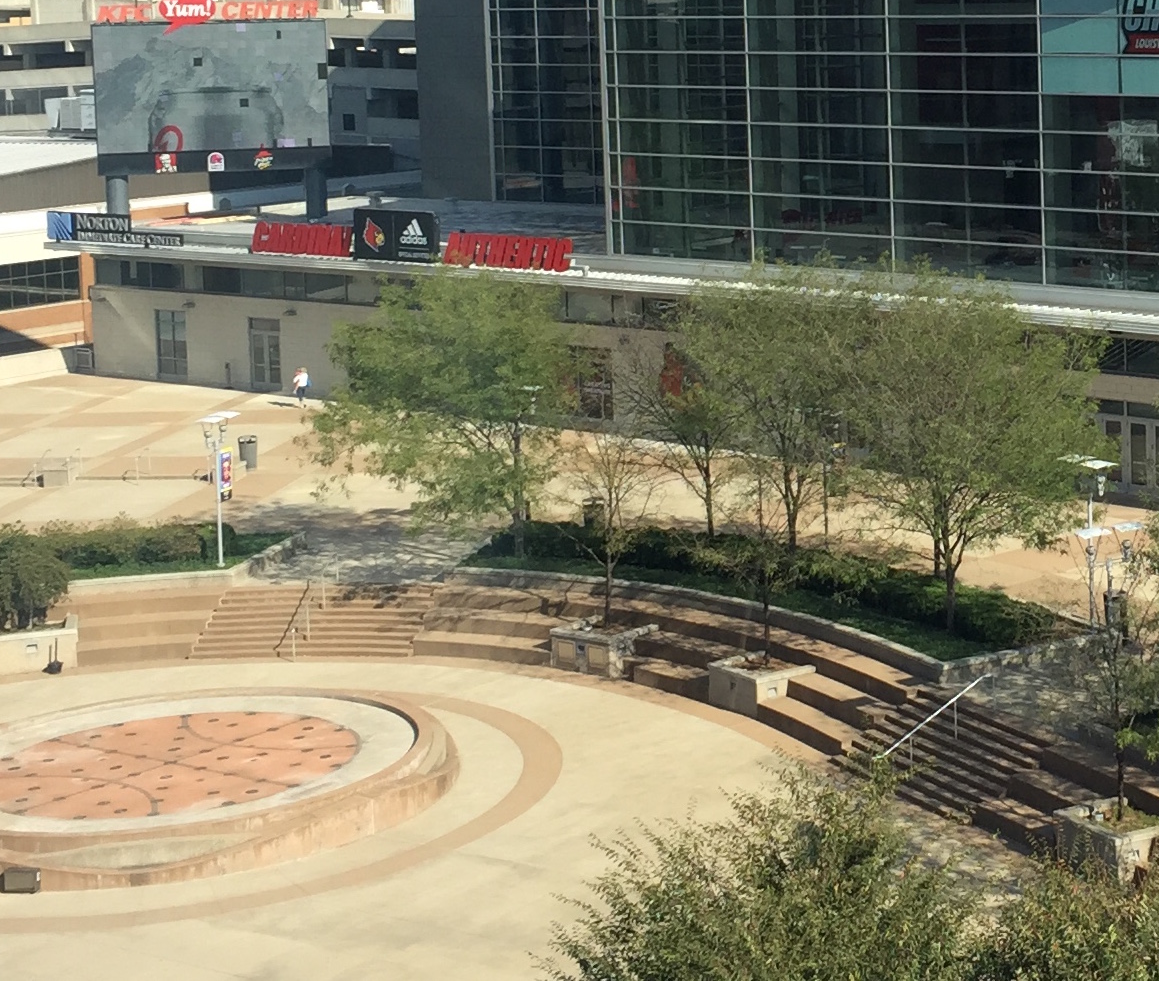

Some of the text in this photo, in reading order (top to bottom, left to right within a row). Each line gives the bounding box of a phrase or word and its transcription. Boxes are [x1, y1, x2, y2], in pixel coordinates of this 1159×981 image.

[97, 0, 319, 23] KFC Yum! CENTER
[76, 213, 130, 232] NORTON
[399, 235, 428, 246] adidas
[443, 231, 574, 272] AUTHENTIC
